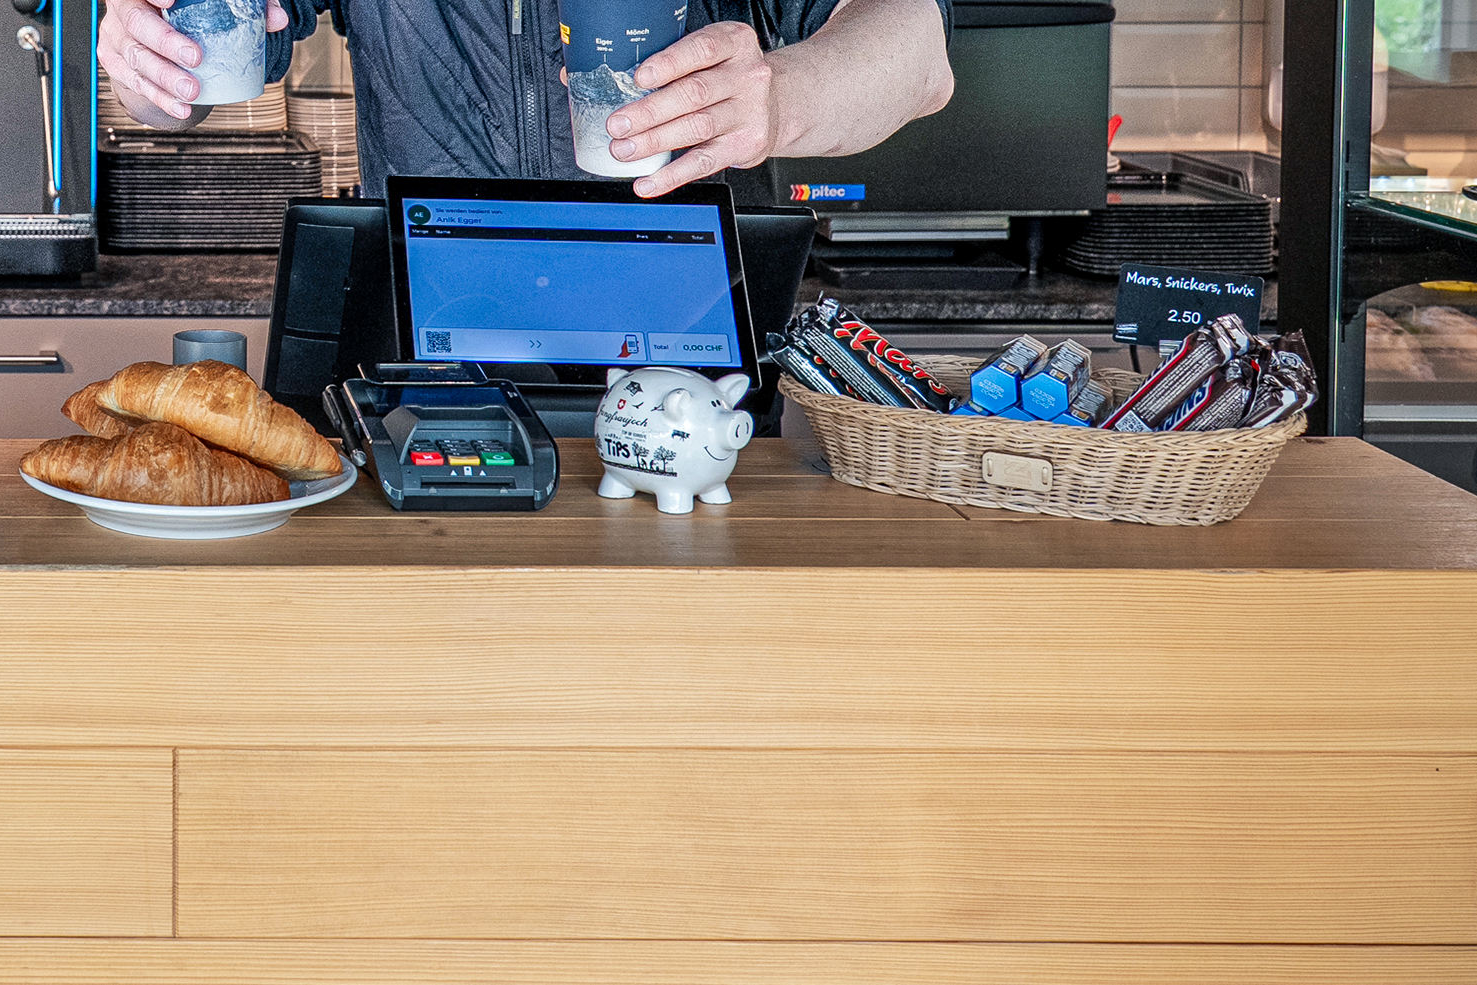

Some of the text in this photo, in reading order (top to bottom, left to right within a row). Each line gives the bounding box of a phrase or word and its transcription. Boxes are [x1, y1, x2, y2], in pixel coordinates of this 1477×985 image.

[626, 27, 650, 36] Mönch
[595, 38, 613, 46] Eiger
[811, 186, 846, 201] pitec
[457, 217, 482, 225] Egger
[1126, 270, 1255, 297] Mars, Snickers, Twix
[1167, 309, 1202, 325] 2.50
